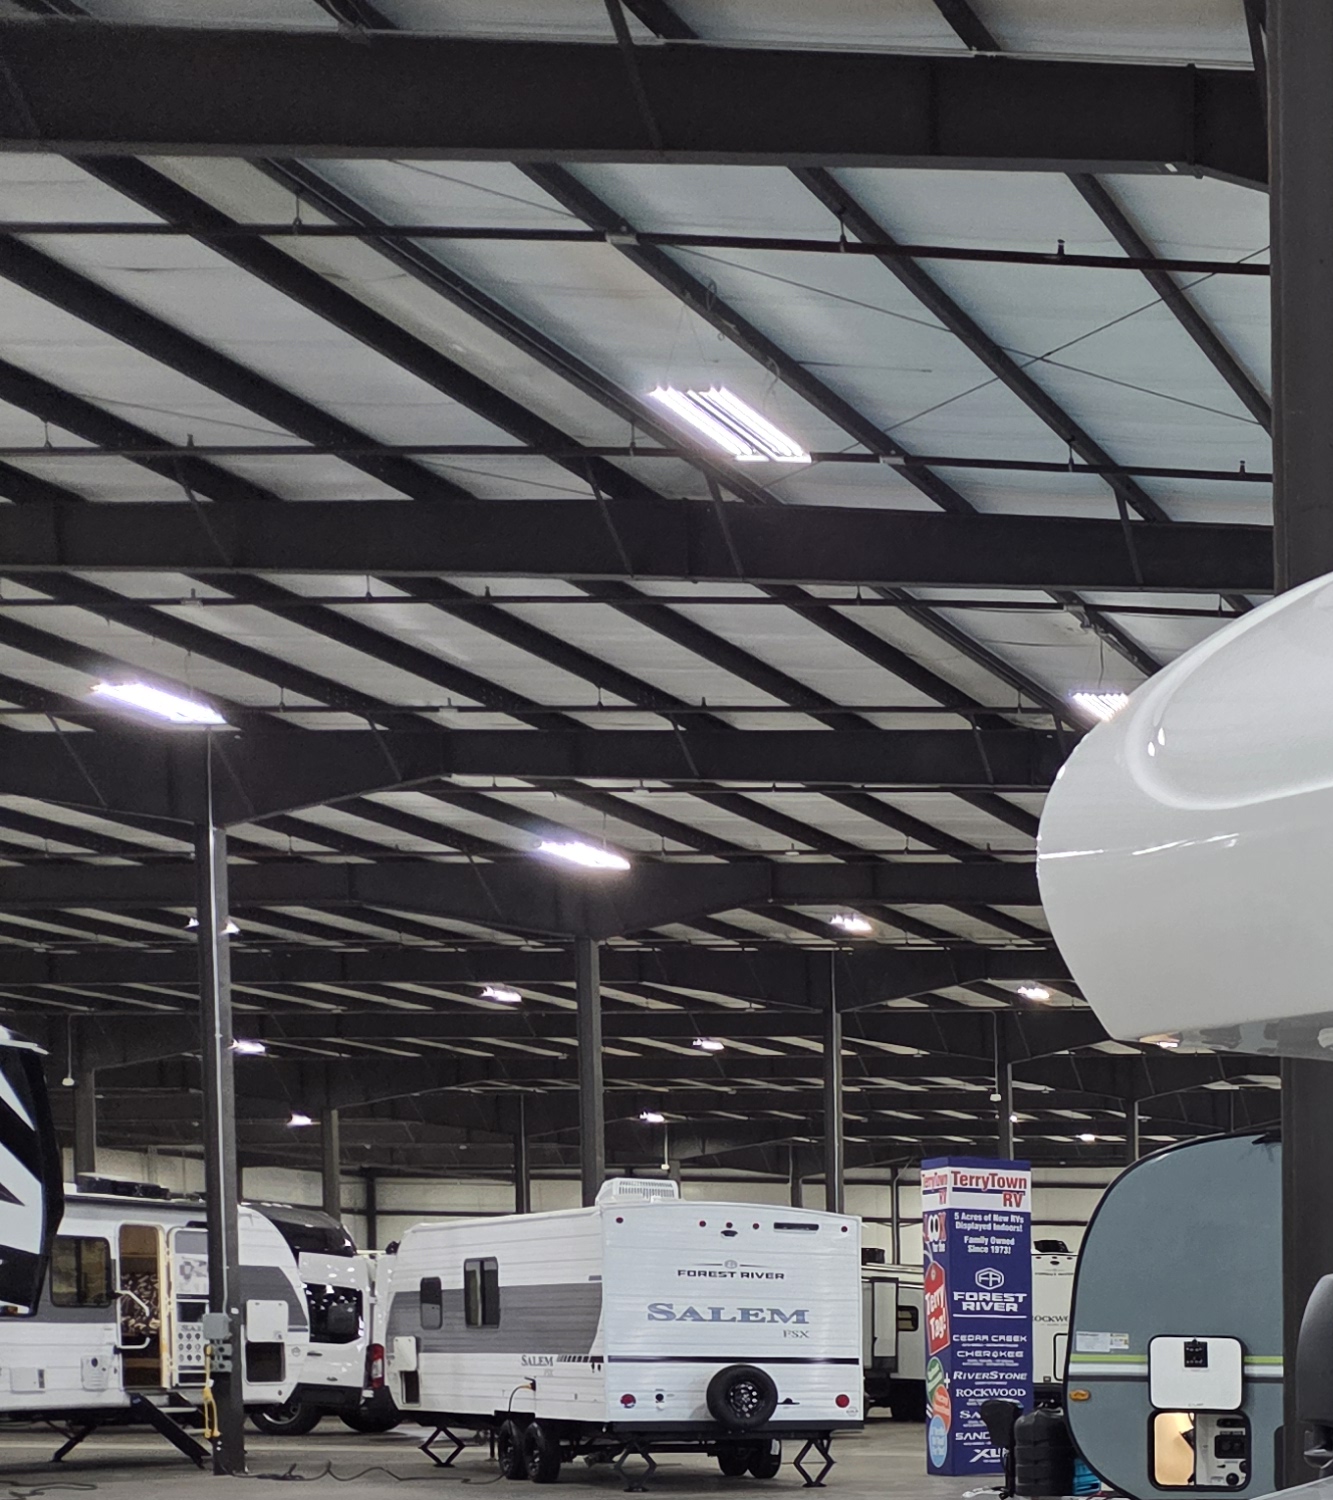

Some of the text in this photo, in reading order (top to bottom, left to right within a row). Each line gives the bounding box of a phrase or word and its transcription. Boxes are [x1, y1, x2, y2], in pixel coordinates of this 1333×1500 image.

[951, 1170, 1028, 1191] TerryTown
[1002, 1191, 1024, 1208] RV
[954, 1212, 960, 1221] 5
[961, 1212, 982, 1221] Acres
[983, 1213, 992, 1221] of
[993, 1213, 1009, 1222] New
[955, 1221, 1023, 1232] Displayed Indoors!
[963, 1236, 1015, 1246] Family Owned
[967, 1245, 1012, 1255] Since 1973!
[677, 1269, 785, 1280] FOREST RIVER
[953, 1291, 1027, 1302] FOREST
[962, 1302, 1018, 1312] RIVER
[647, 1302, 810, 1325] SALEM
[952, 1334, 1027, 1343] CEDAR CREEK
[957, 1350, 1024, 1358] CHEROKEE
[521, 1354, 554, 1367] SALEM
[956, 1388, 1027, 1397] ROCKWOOD
